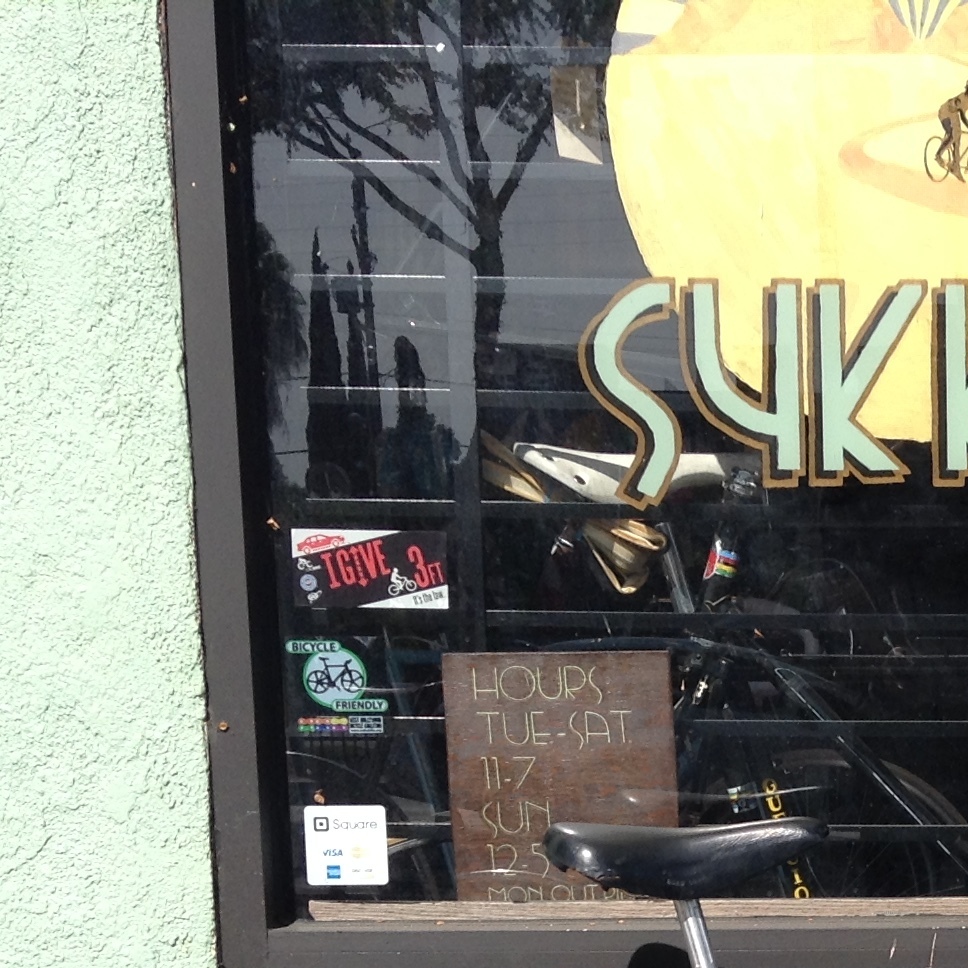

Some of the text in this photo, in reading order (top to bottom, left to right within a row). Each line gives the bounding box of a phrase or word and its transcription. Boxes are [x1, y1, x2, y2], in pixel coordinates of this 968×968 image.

[291, 642, 336, 652] BICYCLE
[472, 665, 603, 704] HOURS
[335, 701, 384, 710] FRIENDLY
[481, 756, 536, 790] 11-7
[332, 818, 378, 830] Square
[482, 800, 551, 839] SUN
[322, 849, 343, 857] VISA
[487, 843, 550, 878] 12-5
